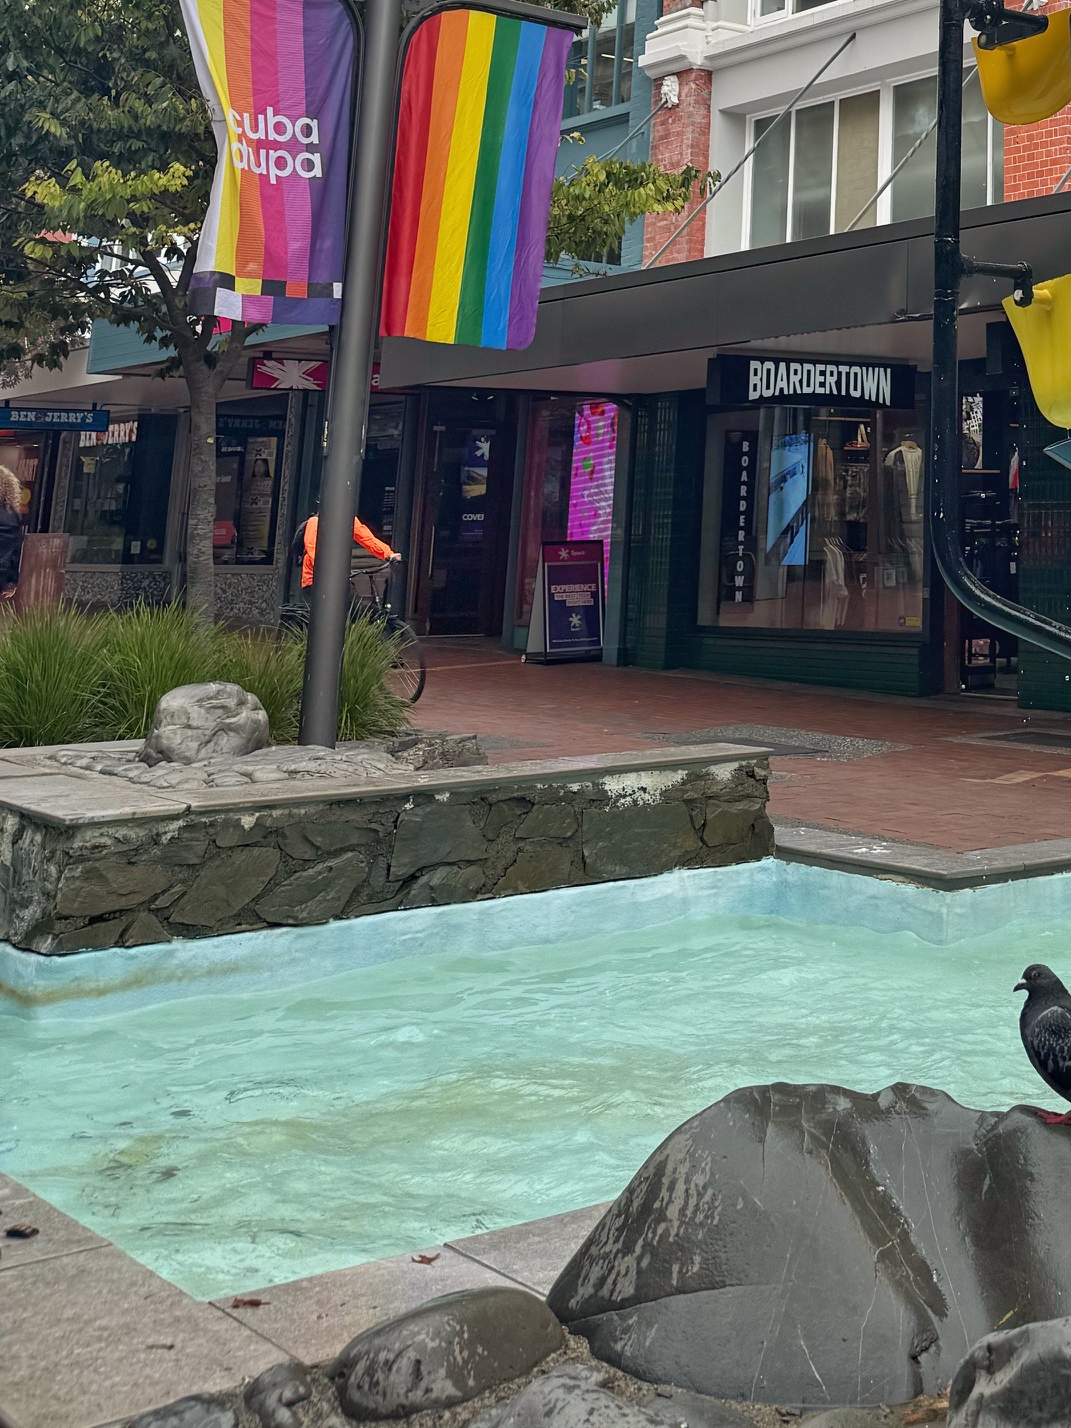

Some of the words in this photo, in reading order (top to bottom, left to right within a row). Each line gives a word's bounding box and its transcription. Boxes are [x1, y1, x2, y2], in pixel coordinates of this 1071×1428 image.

[228, 106, 319, 144] cuba
[230, 137, 323, 185] dupa
[748, 360, 891, 406] BOARDERTOWN
[10, 411, 36, 422] BEN
[45, 412, 94, 423] JERRY'S
[79, 431, 97, 448] BEN
[734, 440, 750, 603] BOARDERTOWN
[551, 584, 597, 593] EXPERIENCE
